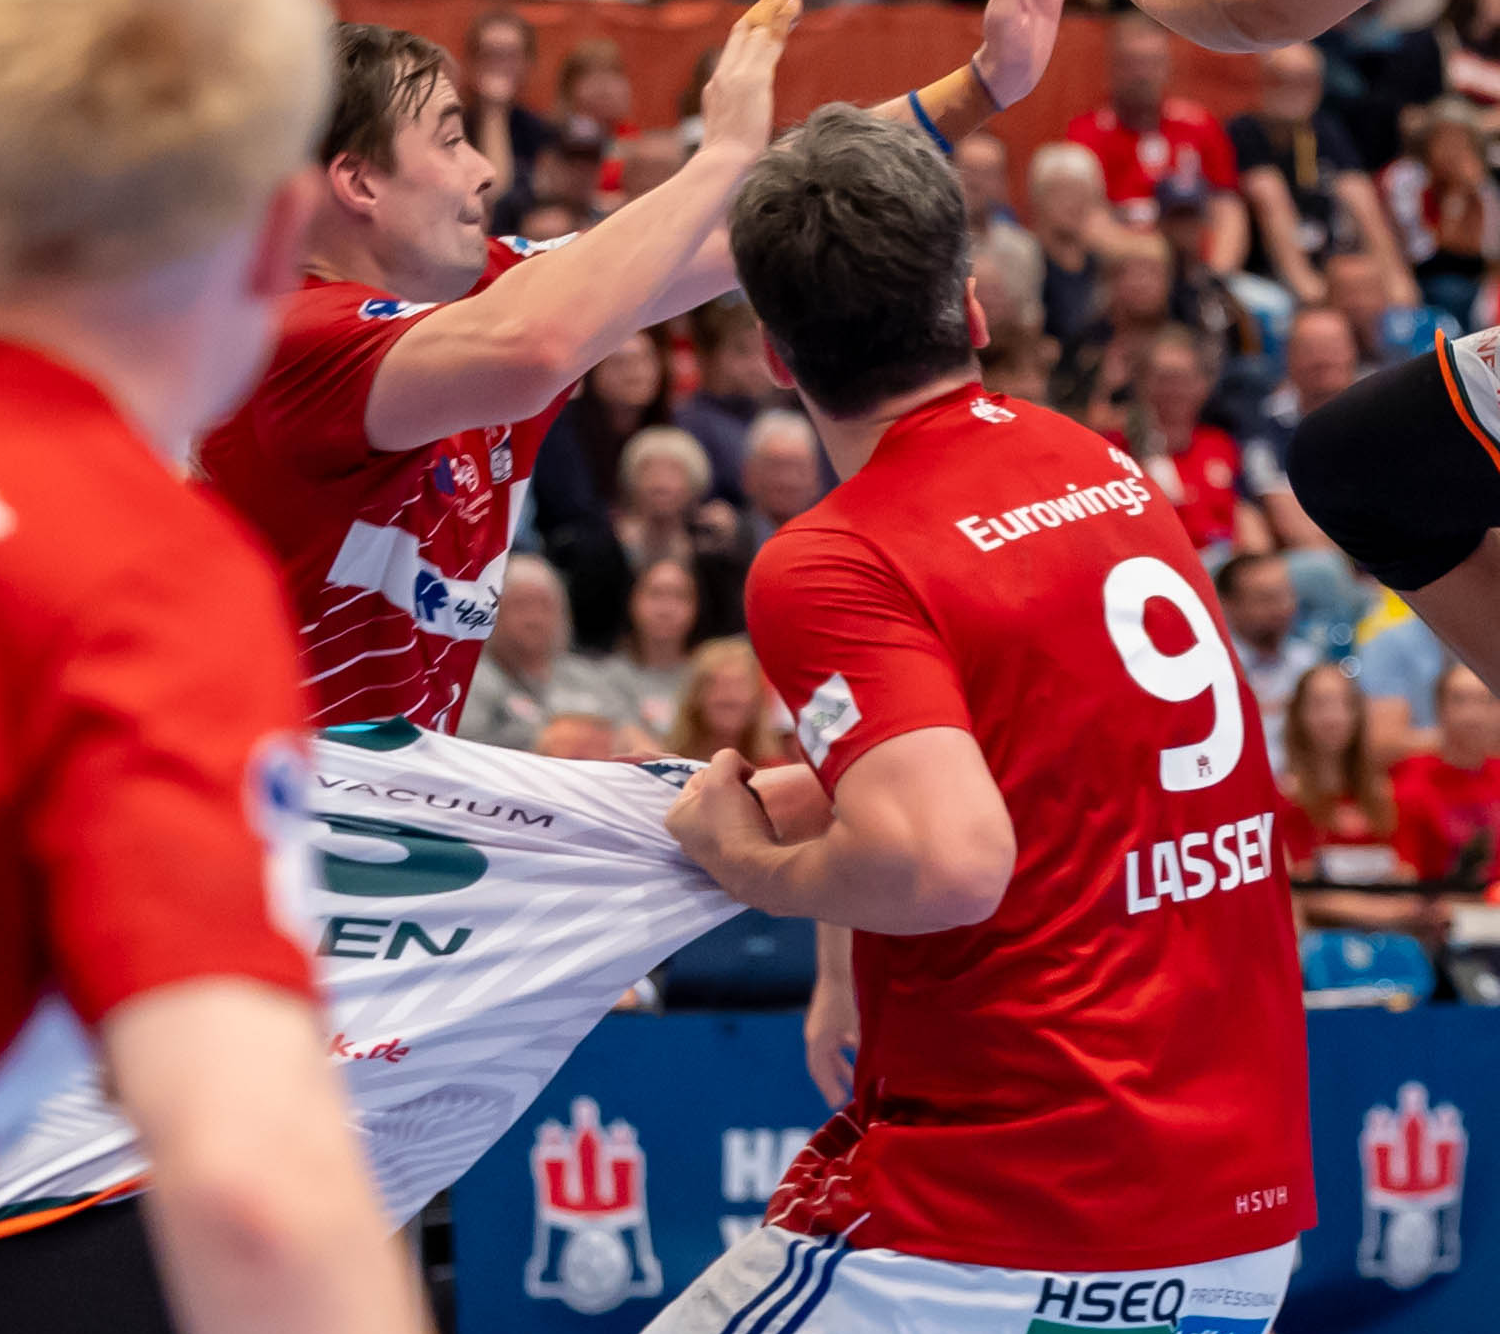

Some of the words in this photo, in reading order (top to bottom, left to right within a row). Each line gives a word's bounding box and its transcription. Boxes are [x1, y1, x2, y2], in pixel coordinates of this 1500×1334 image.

[955, 477, 1152, 553] Eurowings
[1103, 556, 1244, 792] 9
[317, 775, 557, 829] VACUUM
[1235, 1186, 1289, 1215] HSVH
[1034, 1277, 1186, 1328] HSEQ
